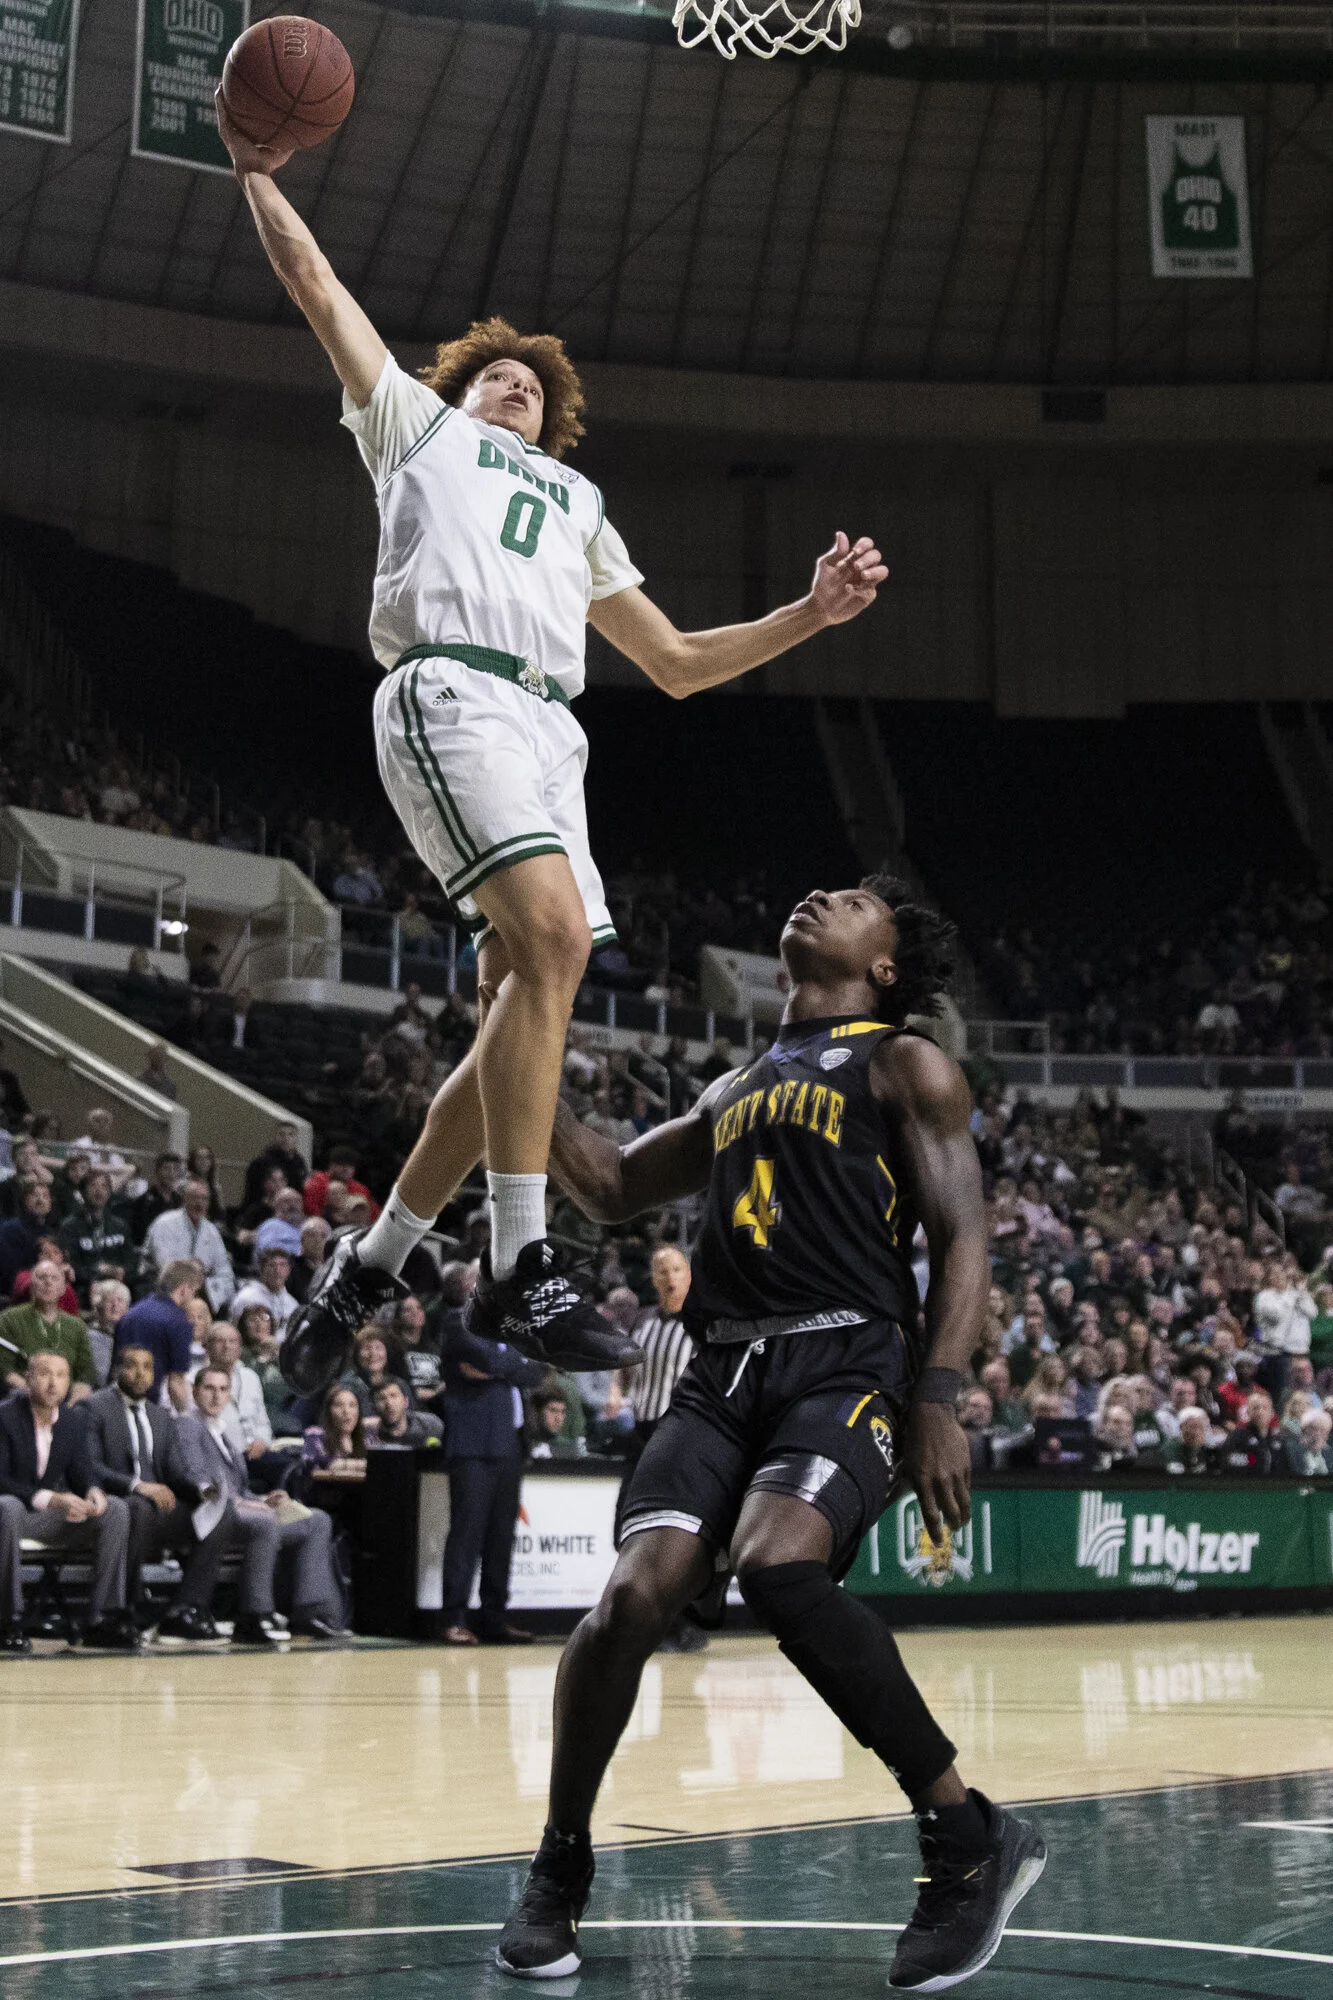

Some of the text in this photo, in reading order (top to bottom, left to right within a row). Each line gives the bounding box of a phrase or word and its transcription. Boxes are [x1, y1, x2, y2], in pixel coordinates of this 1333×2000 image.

[1183, 205, 1218, 232] 40
[500, 490, 547, 558] 0
[767, 1079, 845, 1149] STATE
[733, 1156, 779, 1249] 4
[539, 1535, 596, 1555] WHITE
[1131, 1513, 1260, 1574] Holzer
